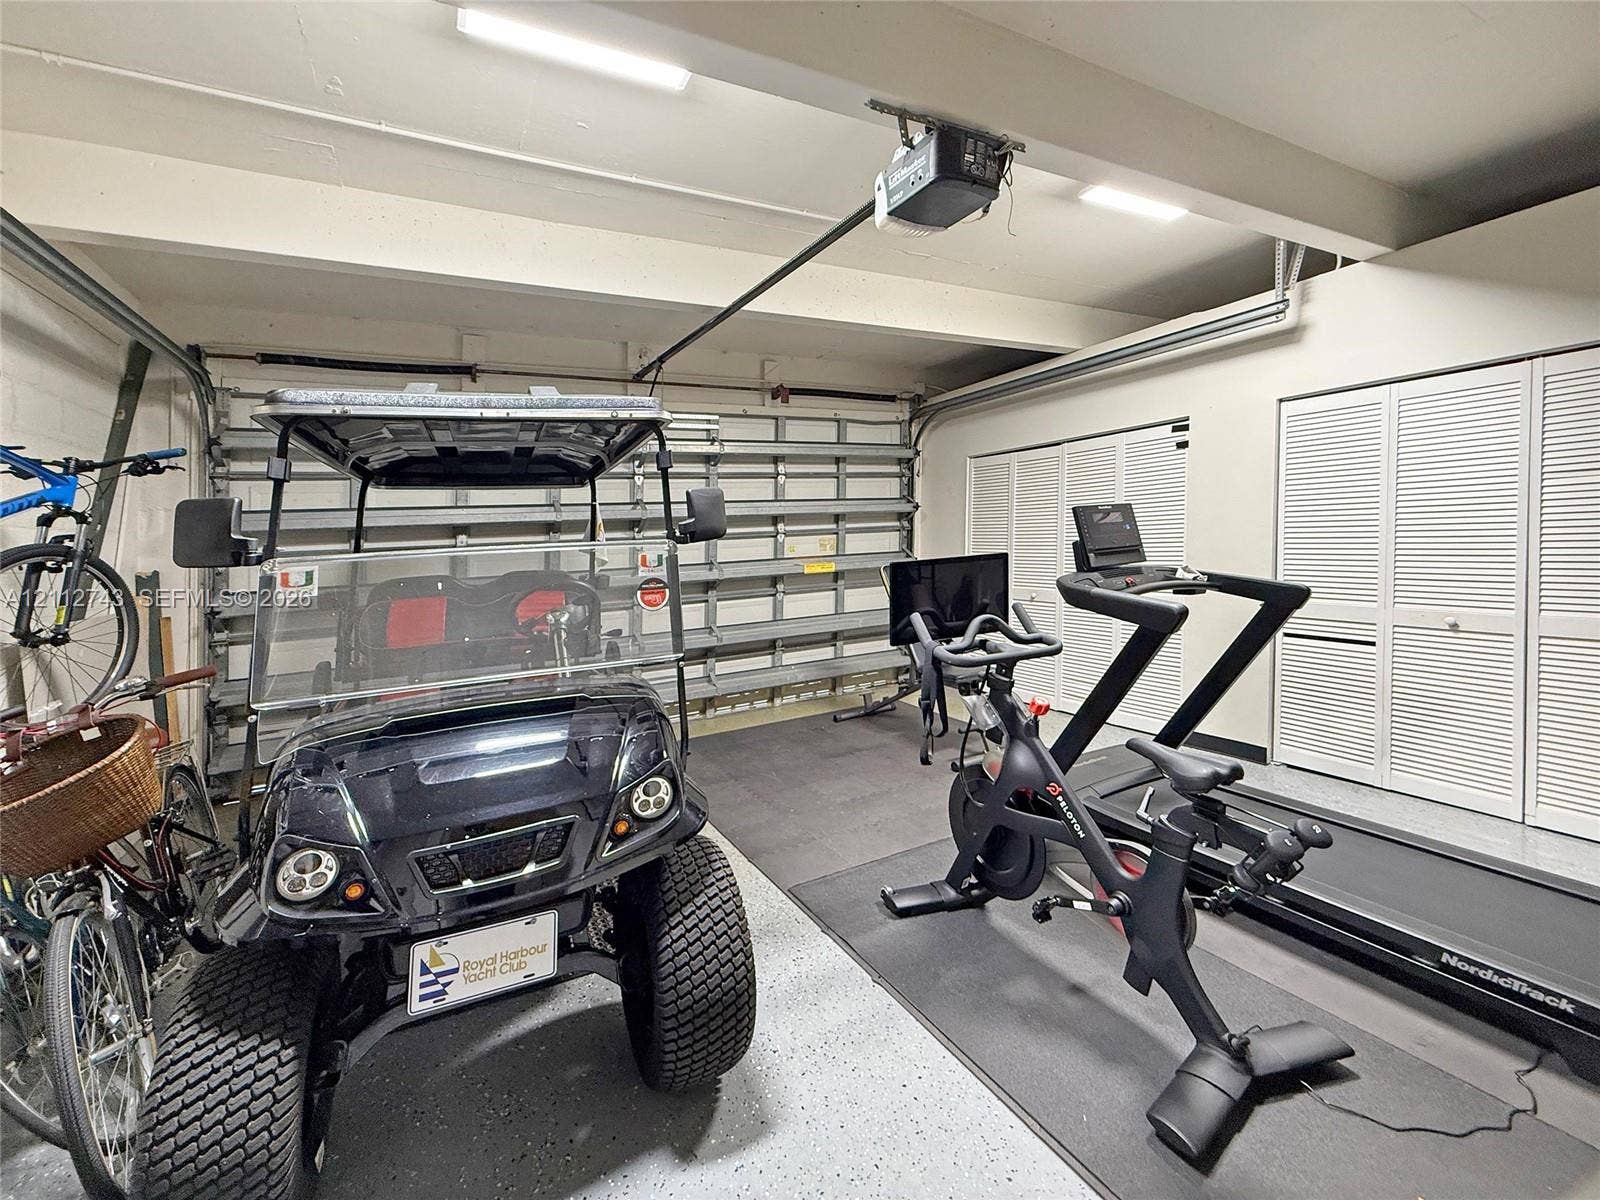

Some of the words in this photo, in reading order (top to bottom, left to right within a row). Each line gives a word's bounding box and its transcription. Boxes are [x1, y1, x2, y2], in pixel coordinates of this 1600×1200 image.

[1056, 795, 1086, 839] PELOTON
[462, 953, 498, 973] Royal
[500, 943, 549, 960] Harbour
[462, 966, 497, 985] Yacht
[499, 959, 528, 975] Club
[1440, 951, 1577, 1014] NordicTrack
